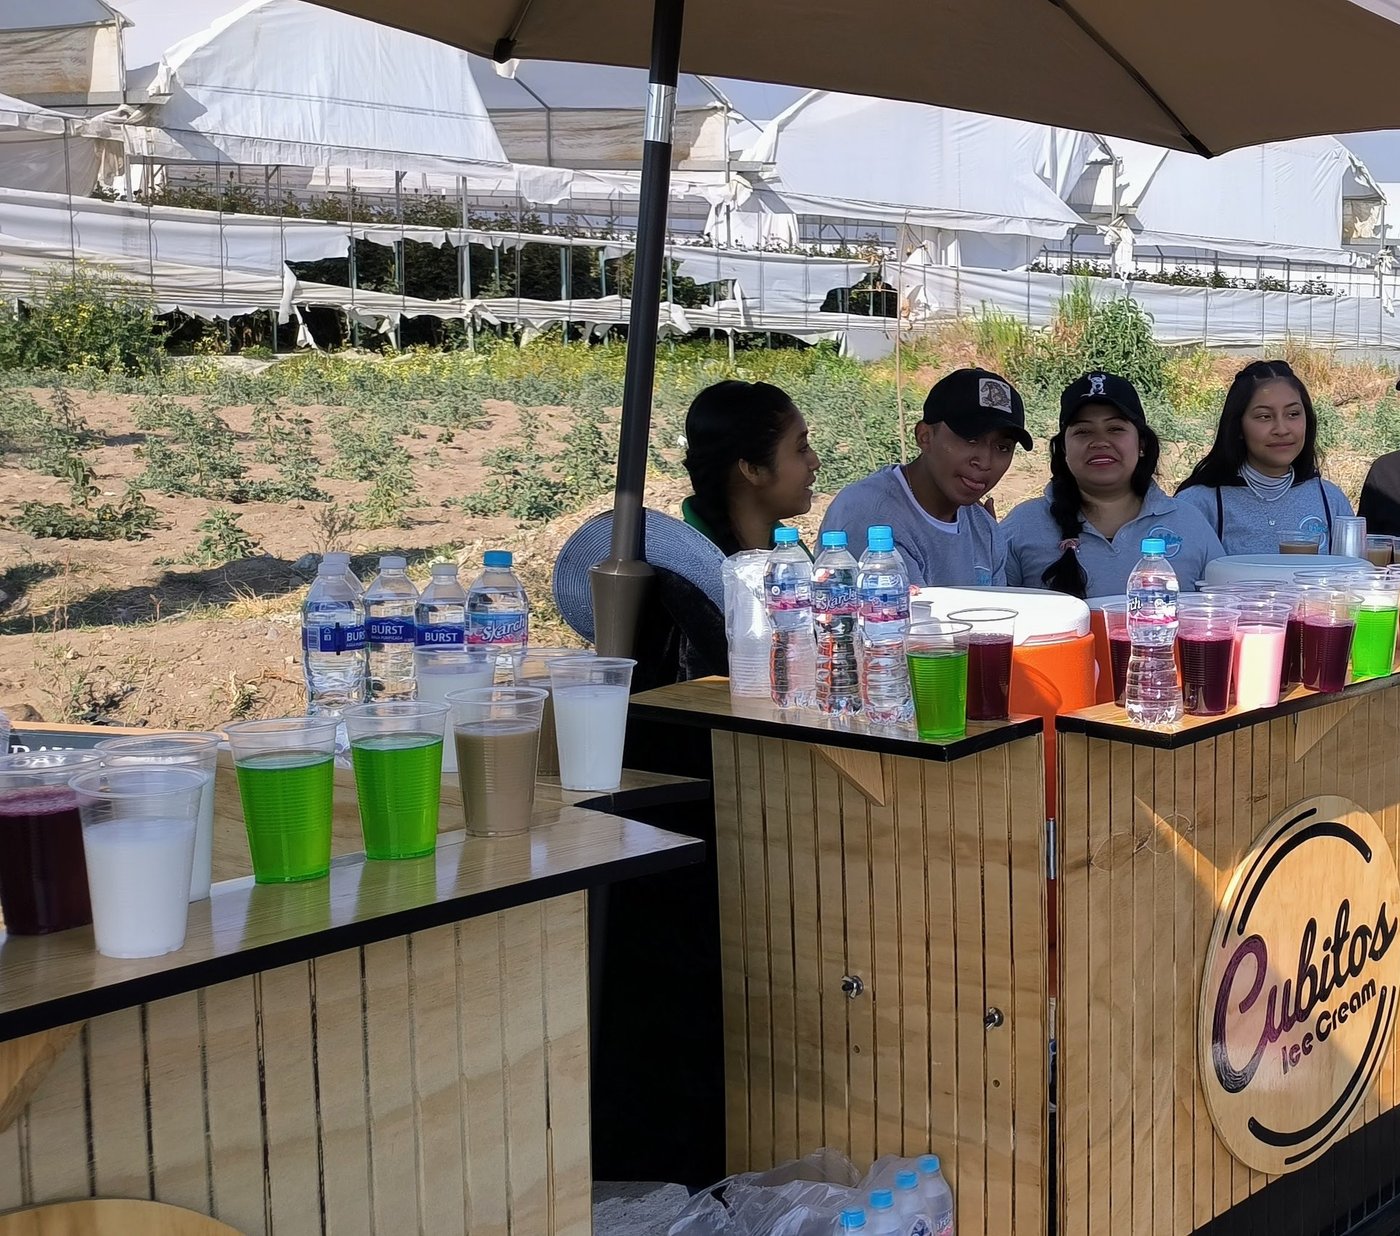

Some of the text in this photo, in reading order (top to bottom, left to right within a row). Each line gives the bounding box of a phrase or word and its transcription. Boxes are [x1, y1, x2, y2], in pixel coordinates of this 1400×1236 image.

[371, 624, 404, 635] BURST
[424, 632, 458, 642] BURST
[1212, 898, 1398, 1094] Cubitos
[1281, 978, 1377, 1075] Ice Cream
